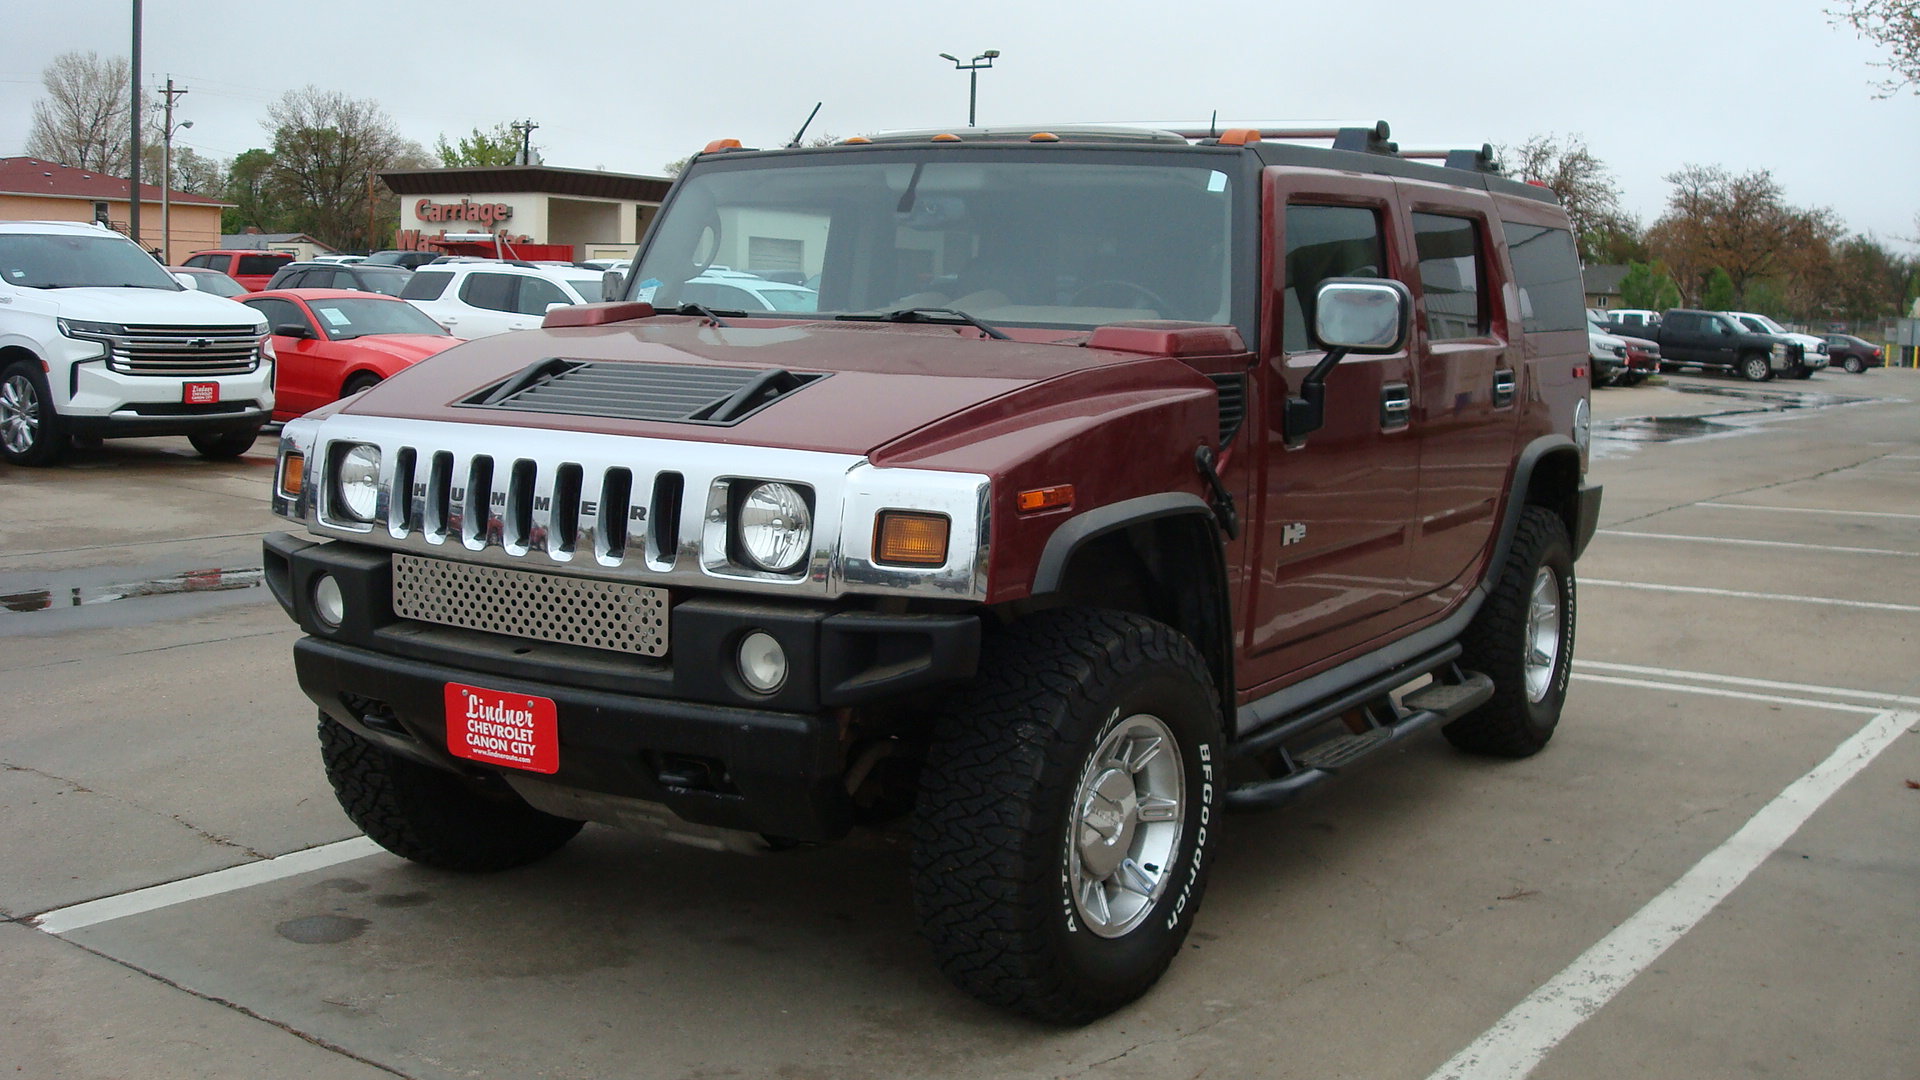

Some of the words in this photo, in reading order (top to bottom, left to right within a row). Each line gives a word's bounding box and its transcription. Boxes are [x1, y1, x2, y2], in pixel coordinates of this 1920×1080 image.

[415, 199, 507, 227] Carriage
[413, 482, 647, 521] HUMMER
[466, 694, 534, 728] Lindner
[466, 733, 508, 752] CANON
[511, 741, 536, 756] CITY
[467, 719, 534, 743] CHEVROLET
[1168, 743, 1213, 930] BFGoodrich
